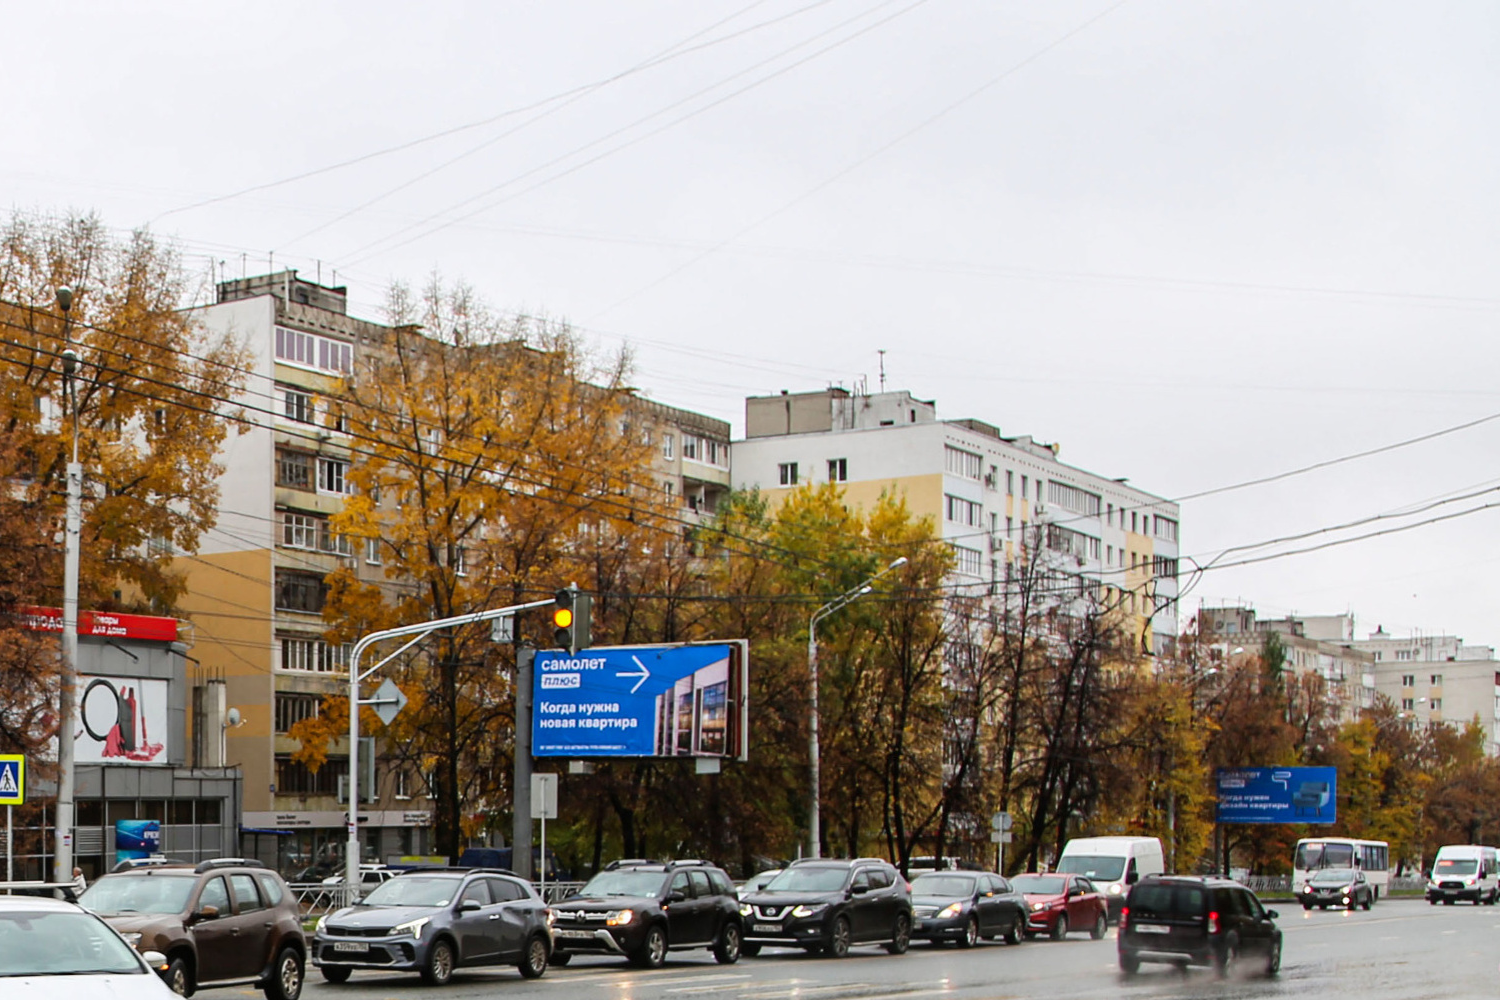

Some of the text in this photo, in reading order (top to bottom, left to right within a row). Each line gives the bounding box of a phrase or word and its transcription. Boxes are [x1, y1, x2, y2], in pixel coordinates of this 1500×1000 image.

[541, 658, 607, 671] самолет
[543, 676, 578, 686] плюс
[540, 701, 620, 716] Когда нужна
[540, 717, 638, 731] новая квартира
